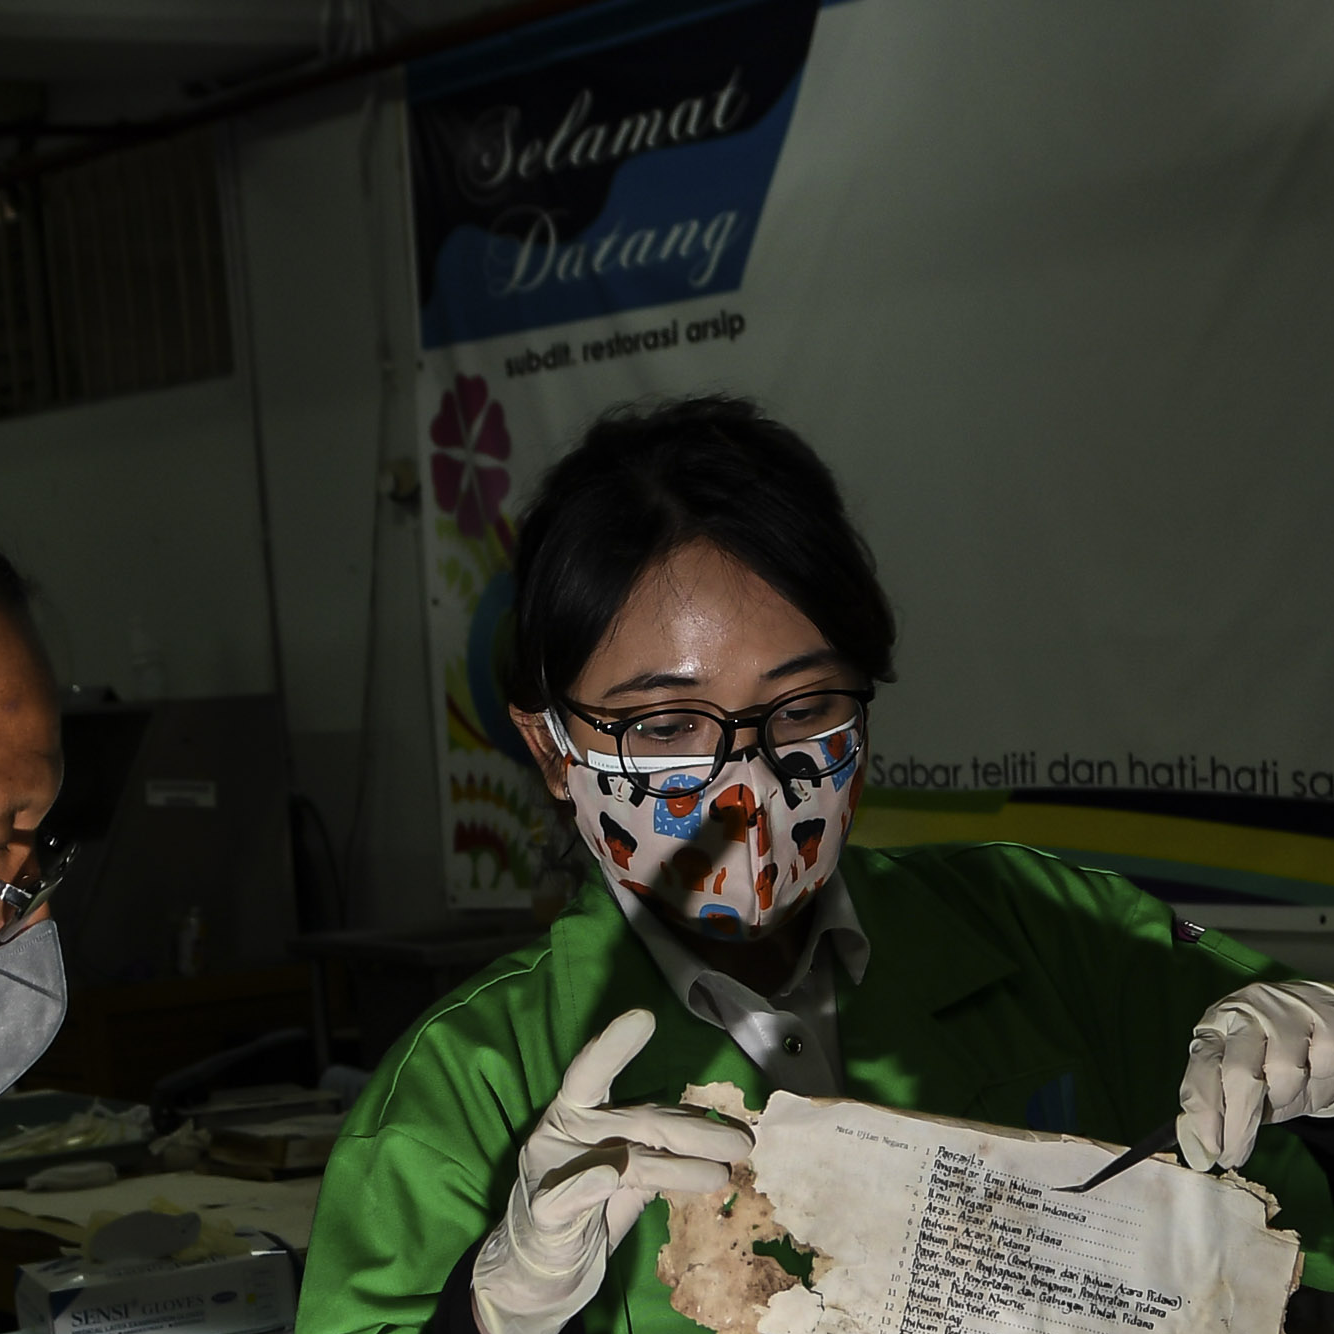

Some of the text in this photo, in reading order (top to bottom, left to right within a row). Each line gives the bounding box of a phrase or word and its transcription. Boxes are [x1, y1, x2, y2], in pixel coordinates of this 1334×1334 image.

[463, 65, 745, 192] Selamat
[485, 205, 741, 294] Datang
[505, 308, 745, 378] subdit. restorasi arsip
[972, 751, 1038, 788] teliti
[1048, 752, 1118, 788] dan
[1128, 754, 1279, 799] hati-hati
[836, 1126, 909, 1149] Mata Ujian Negara
[934, 1159, 979, 1178] Pengantar
[984, 1173, 1006, 1186] Ilmu
[1009, 1180, 1042, 1197] Hukum
[928, 1188, 951, 1202] Ilmu
[956, 1196, 993, 1214] Negara
[930, 1174, 976, 1193] Pengantar
[983, 1187, 1003, 1201] Tata
[1006, 1195, 1038, 1210] Hukum
[1042, 1203, 1086, 1223] Indonesia
[921, 1216, 957, 1232] Hukum
[962, 1228, 993, 1242] Acara
[997, 1235, 1031, 1252] Pidana
[989, 1219, 1022, 1235] Hukum
[1027, 1229, 1062, 1246] Pidana
[911, 1272, 940, 1289] Tindak
[919, 1230, 948, 1246] Hukum
[1083, 1273, 1113, 1290] Hukum
[1115, 1283, 1143, 1298] Acara
[71, 1303, 129, 1328] SENSI
[142, 1295, 205, 1315] GLOVES
[908, 1287, 941, 1305] Hukum
[1017, 1286, 1035, 1298] dan
[1089, 1303, 1117, 1319] Tindak
[1122, 1313, 1155, 1330] Pidana
[1135, 1302, 1166, 1318] Pidana
[900, 1315, 938, 1332] Hukum
